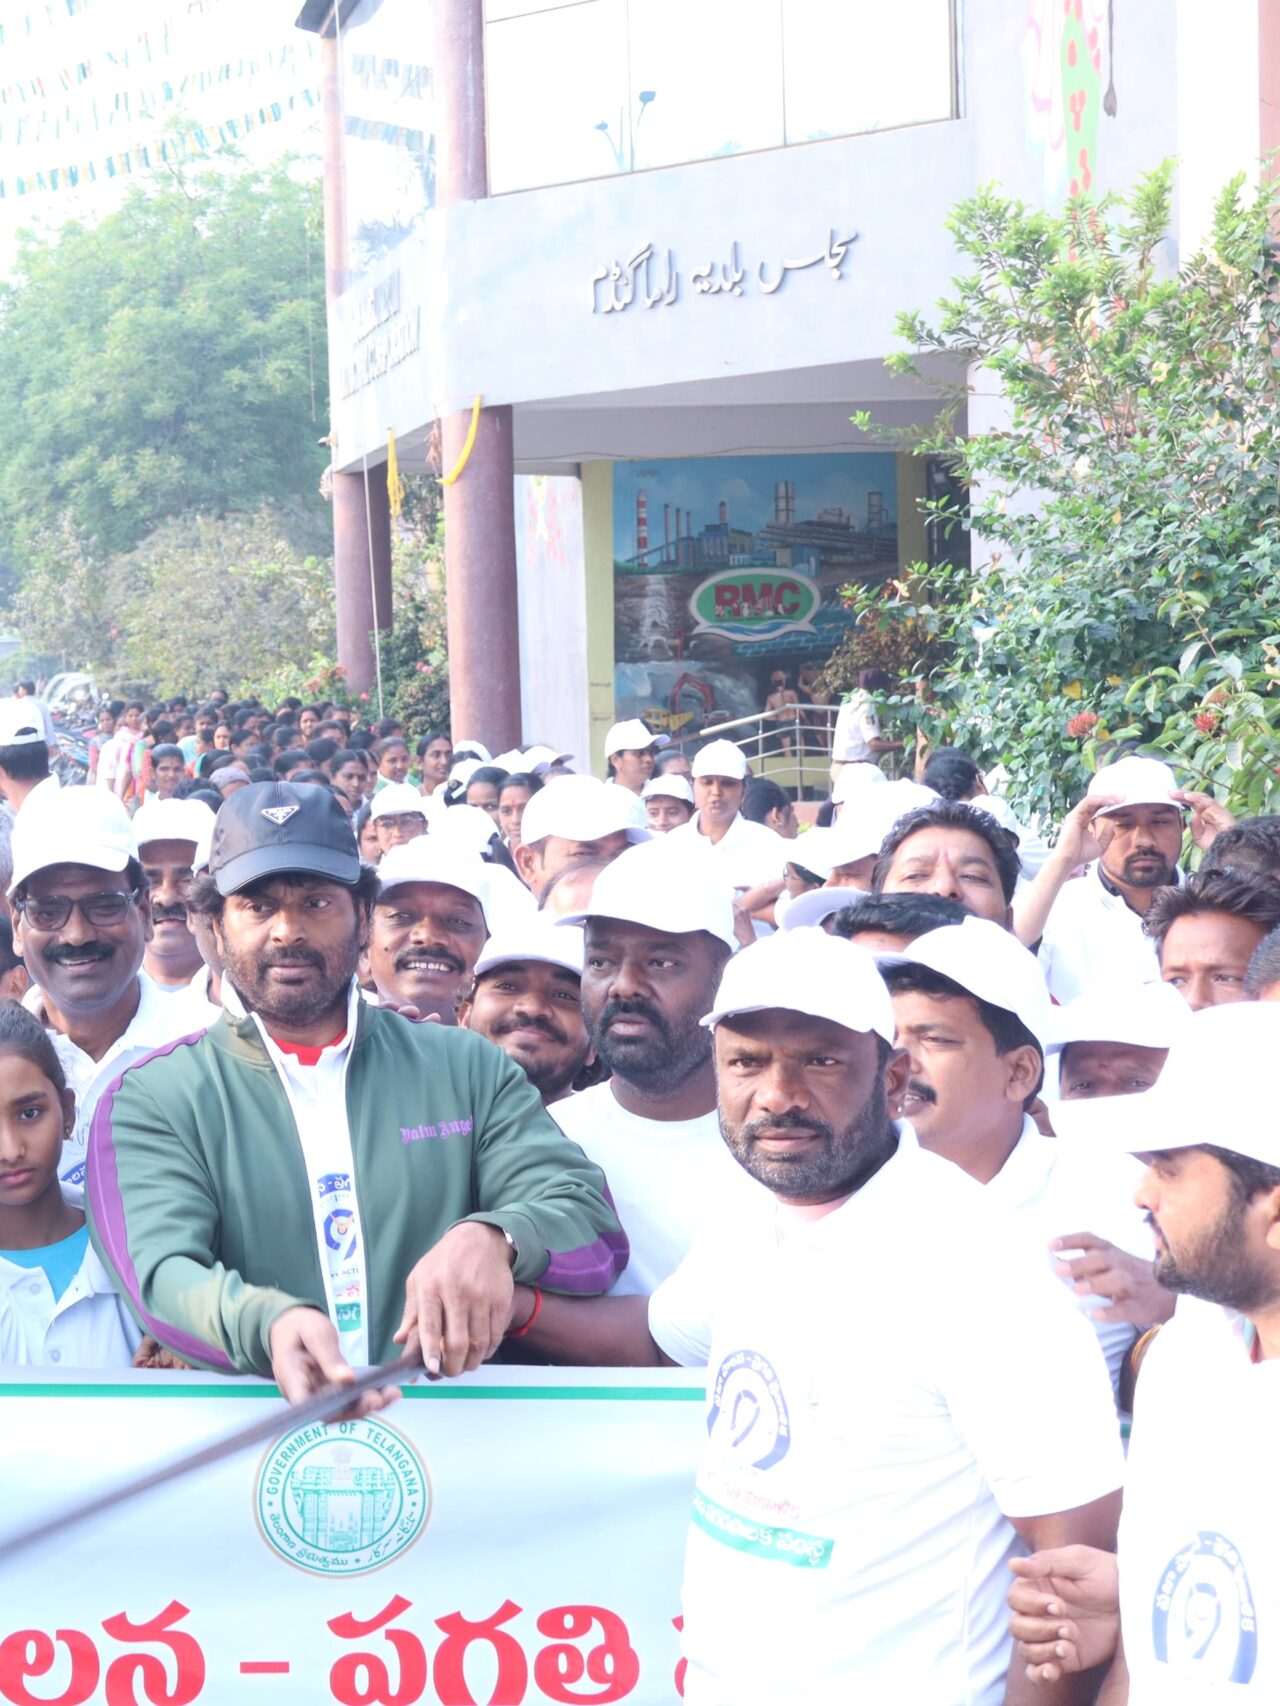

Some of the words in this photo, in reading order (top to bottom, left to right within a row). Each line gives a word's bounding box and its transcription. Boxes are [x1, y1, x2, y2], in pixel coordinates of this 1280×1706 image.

[714, 581, 801, 619] RMC
[266, 1422, 330, 1496] GOVERNMENT
[339, 1421, 357, 1435] OF
[366, 1427, 419, 1497] TELANGANA
